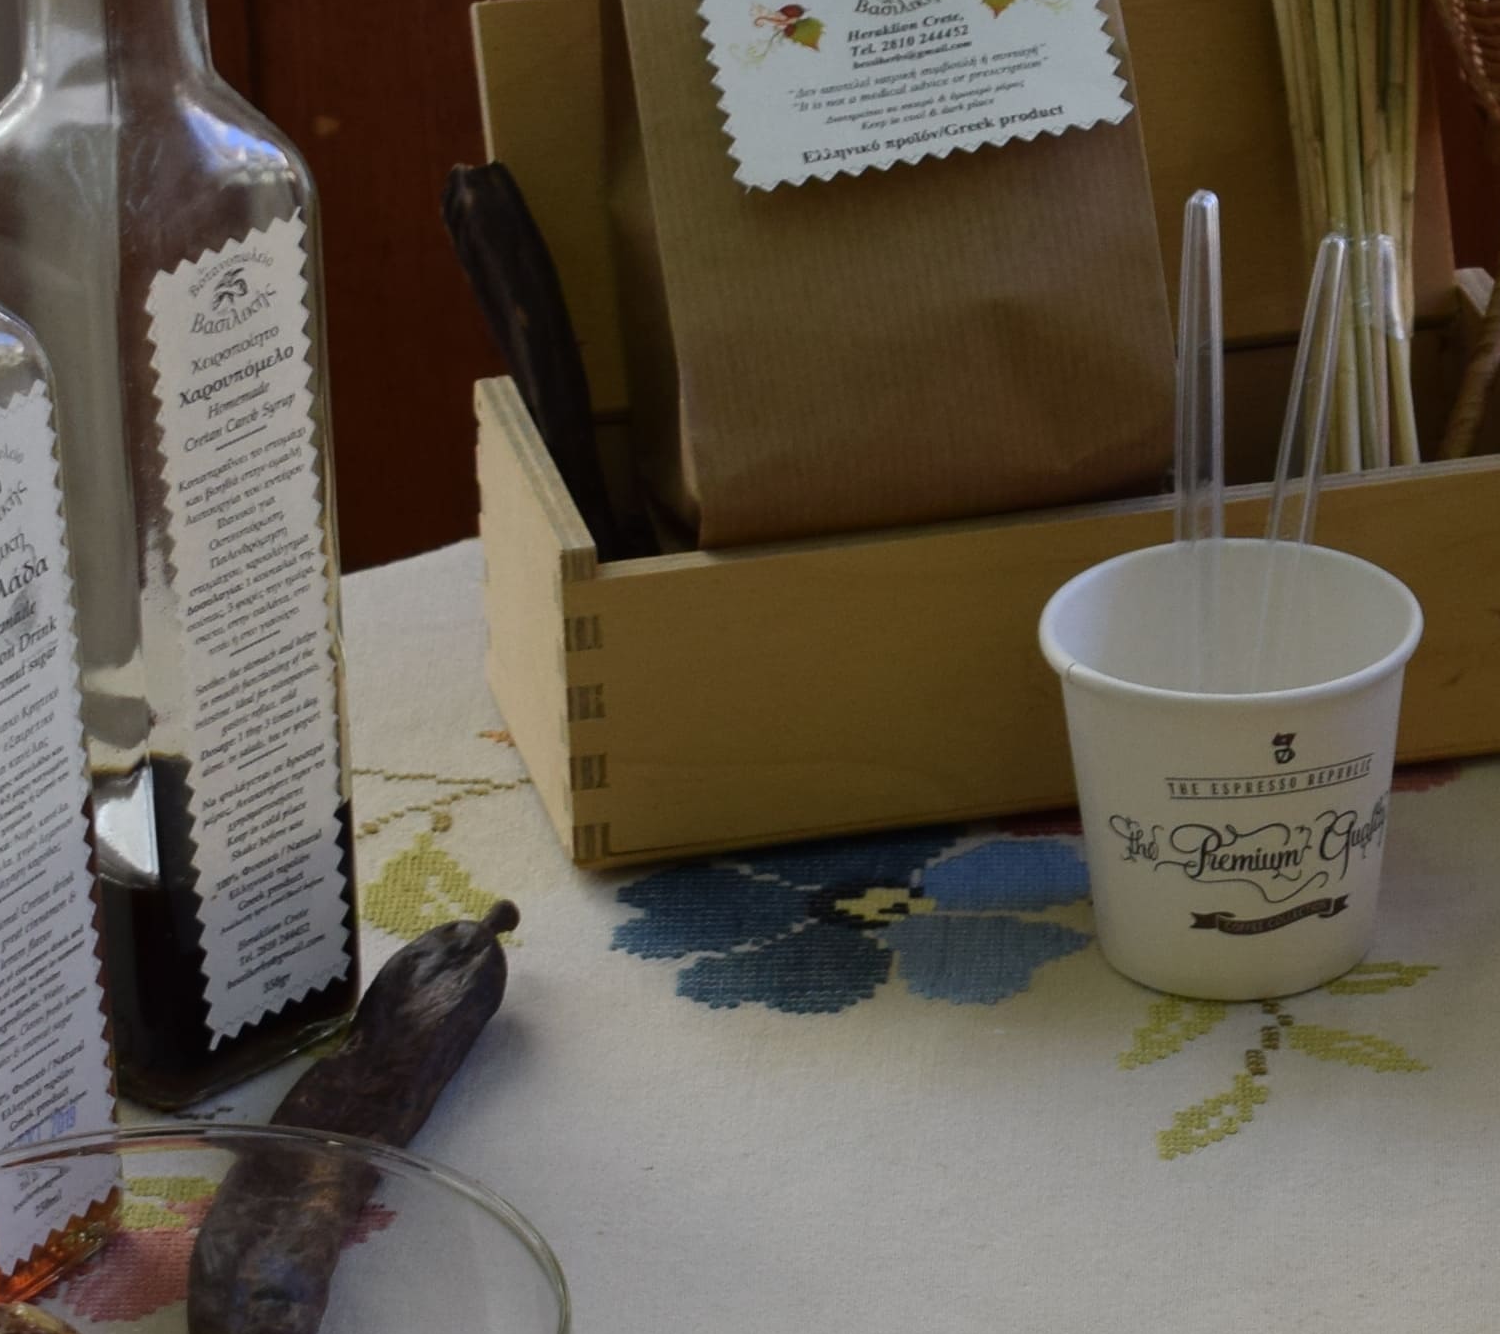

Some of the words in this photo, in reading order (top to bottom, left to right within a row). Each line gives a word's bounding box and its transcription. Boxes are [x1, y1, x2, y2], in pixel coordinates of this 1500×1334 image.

[847, 22, 917, 41] Heraklion
[999, 105, 1062, 127] product
[1167, 782, 1199, 797] THE
[1211, 777, 1298, 797] ESPRESSO
[1308, 757, 1372, 787] REPUBLIC
[1109, 814, 1164, 864] The
[1157, 823, 1312, 881] Premium
